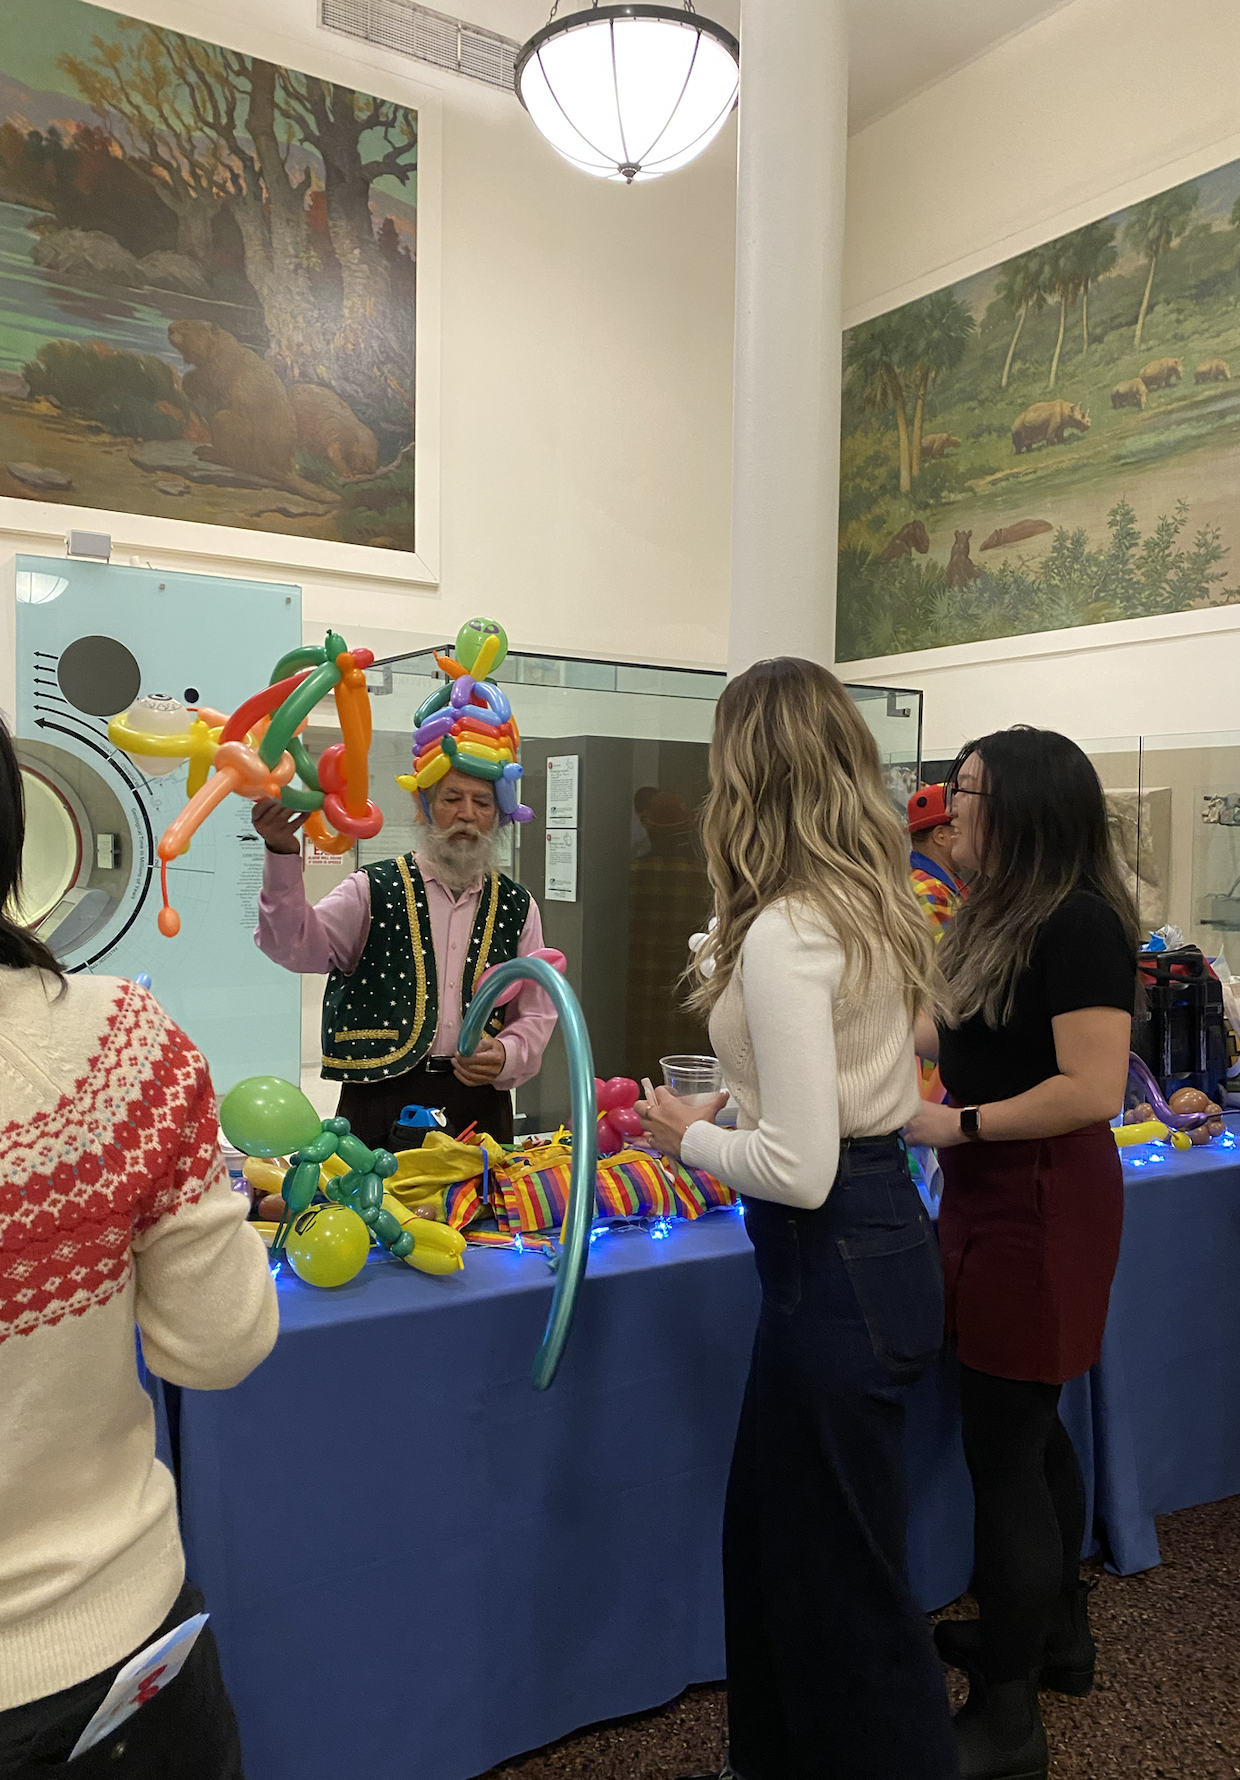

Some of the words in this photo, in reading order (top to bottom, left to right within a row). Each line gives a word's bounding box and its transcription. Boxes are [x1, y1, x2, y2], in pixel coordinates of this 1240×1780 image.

[131, 807, 143, 836] Geological
[137, 856, 145, 877] Millions
[131, 885, 139, 900] Years
